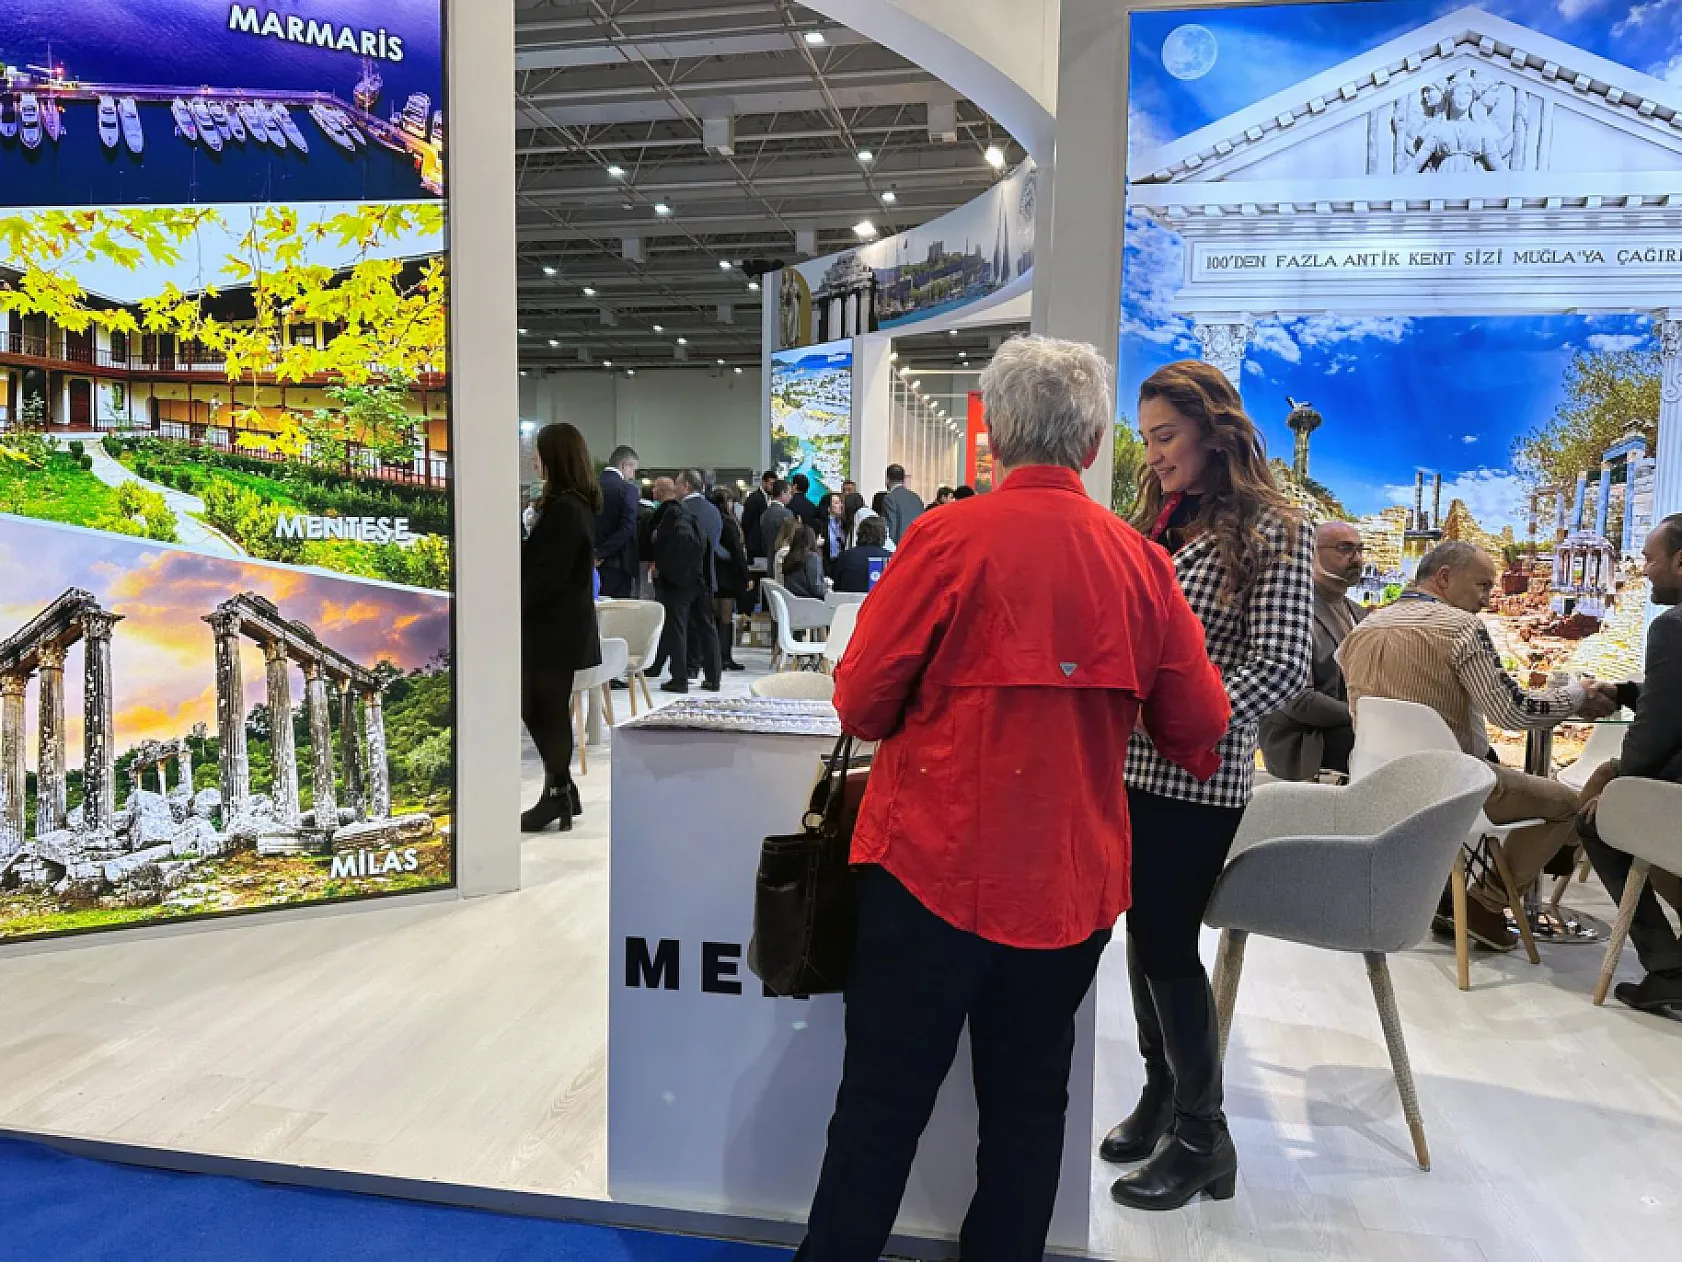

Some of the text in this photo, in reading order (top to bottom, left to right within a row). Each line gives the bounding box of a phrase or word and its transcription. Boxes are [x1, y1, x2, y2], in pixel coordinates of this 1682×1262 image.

[229, 4, 403, 62] MARMARİS
[1206, 246, 1682, 269] 100'DEN FAZLA ANTİK KENT SİZİ MUĞLA'YA ÇAĞIR
[275, 513, 409, 544] MENTEŞE
[330, 848, 417, 878] MİLAS
[625, 936, 811, 1000] ME
